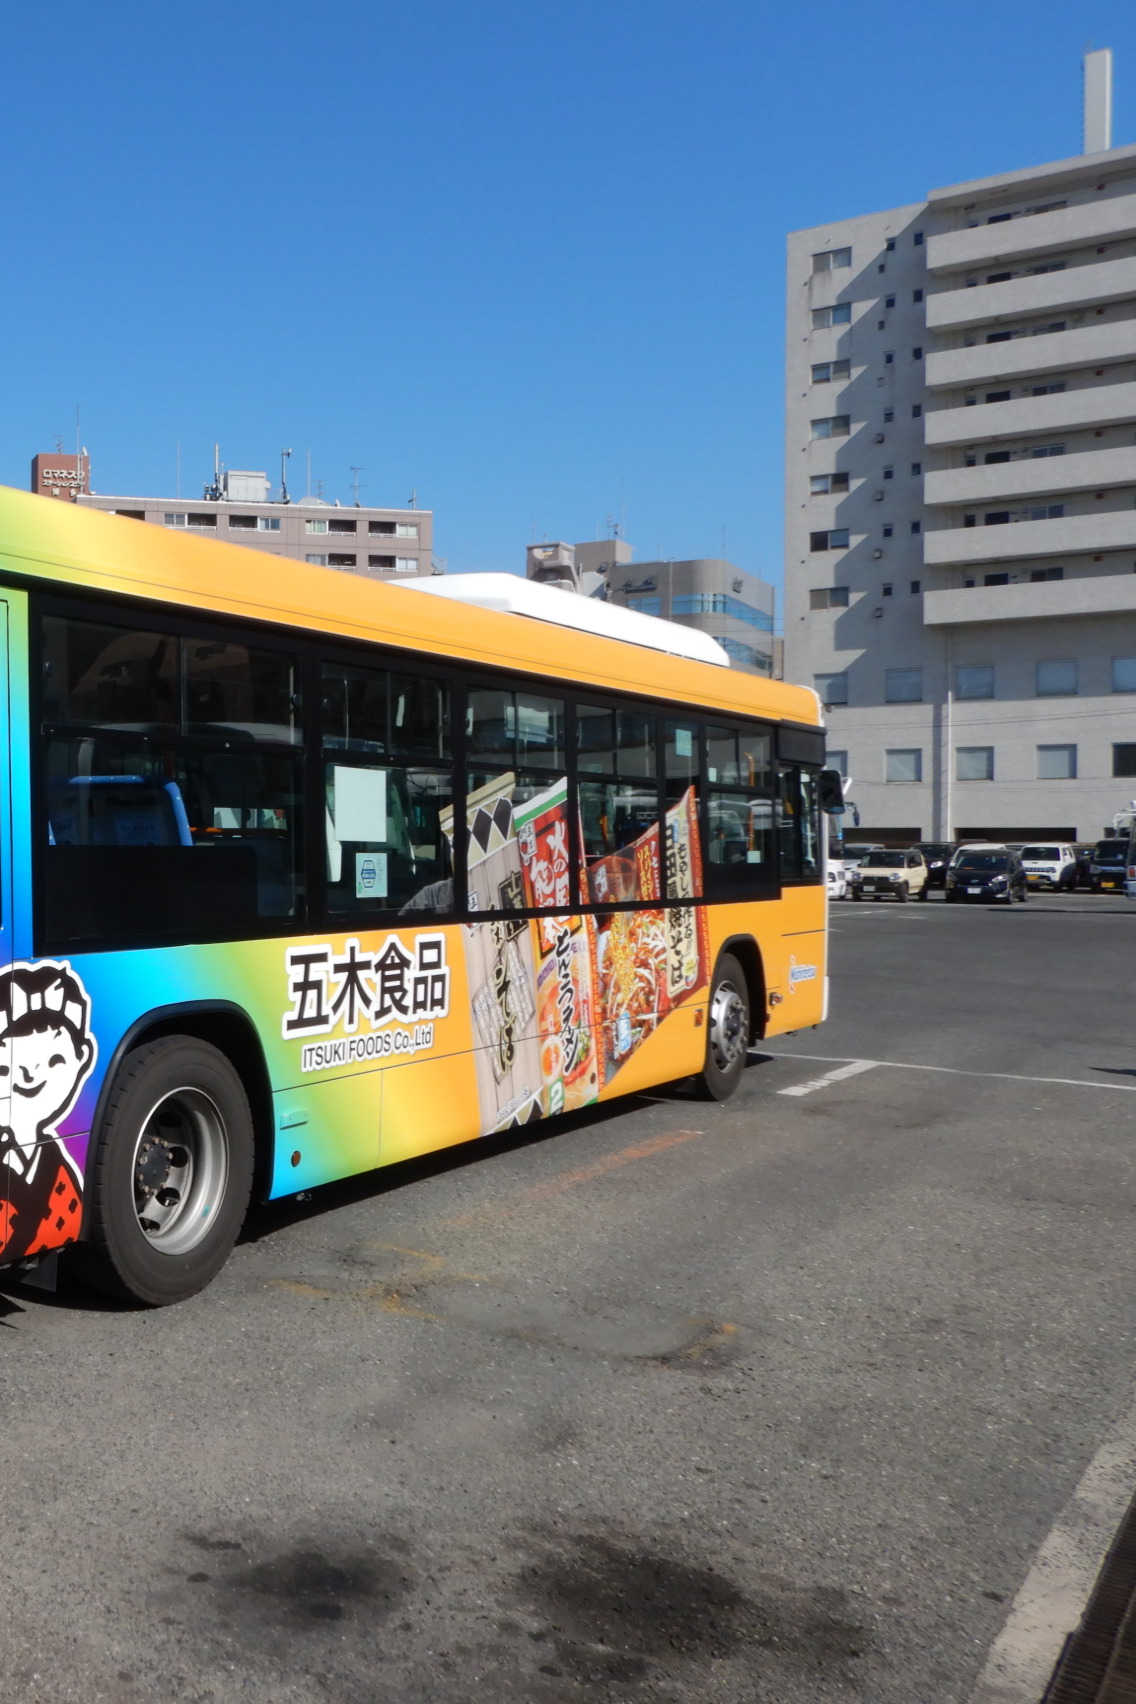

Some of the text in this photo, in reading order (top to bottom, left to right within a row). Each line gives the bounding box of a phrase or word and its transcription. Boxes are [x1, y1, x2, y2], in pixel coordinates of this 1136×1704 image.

[285, 938, 447, 1033] 五木食品
[303, 1041, 346, 1069] ITSUKI
[348, 1033, 392, 1060] FOODS
